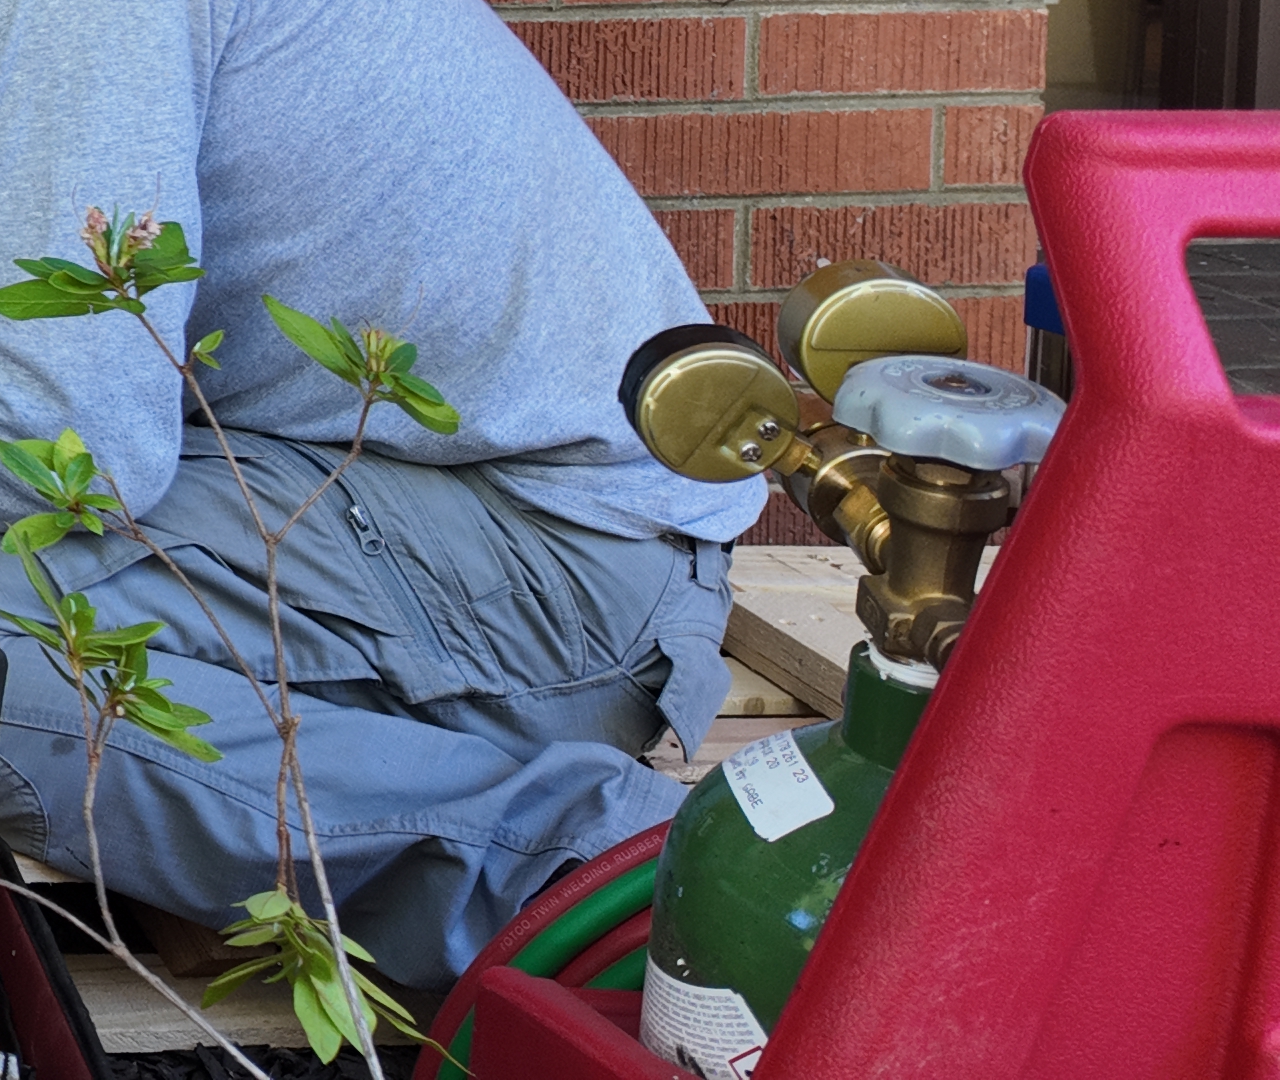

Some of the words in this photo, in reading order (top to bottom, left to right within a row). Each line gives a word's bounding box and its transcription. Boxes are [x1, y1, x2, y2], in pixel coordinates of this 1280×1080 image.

[792, 768, 809, 783] 23
[531, 895, 560, 921] TWIN
[559, 861, 611, 898] WELDING
[614, 834, 663, 866] RUBBER
